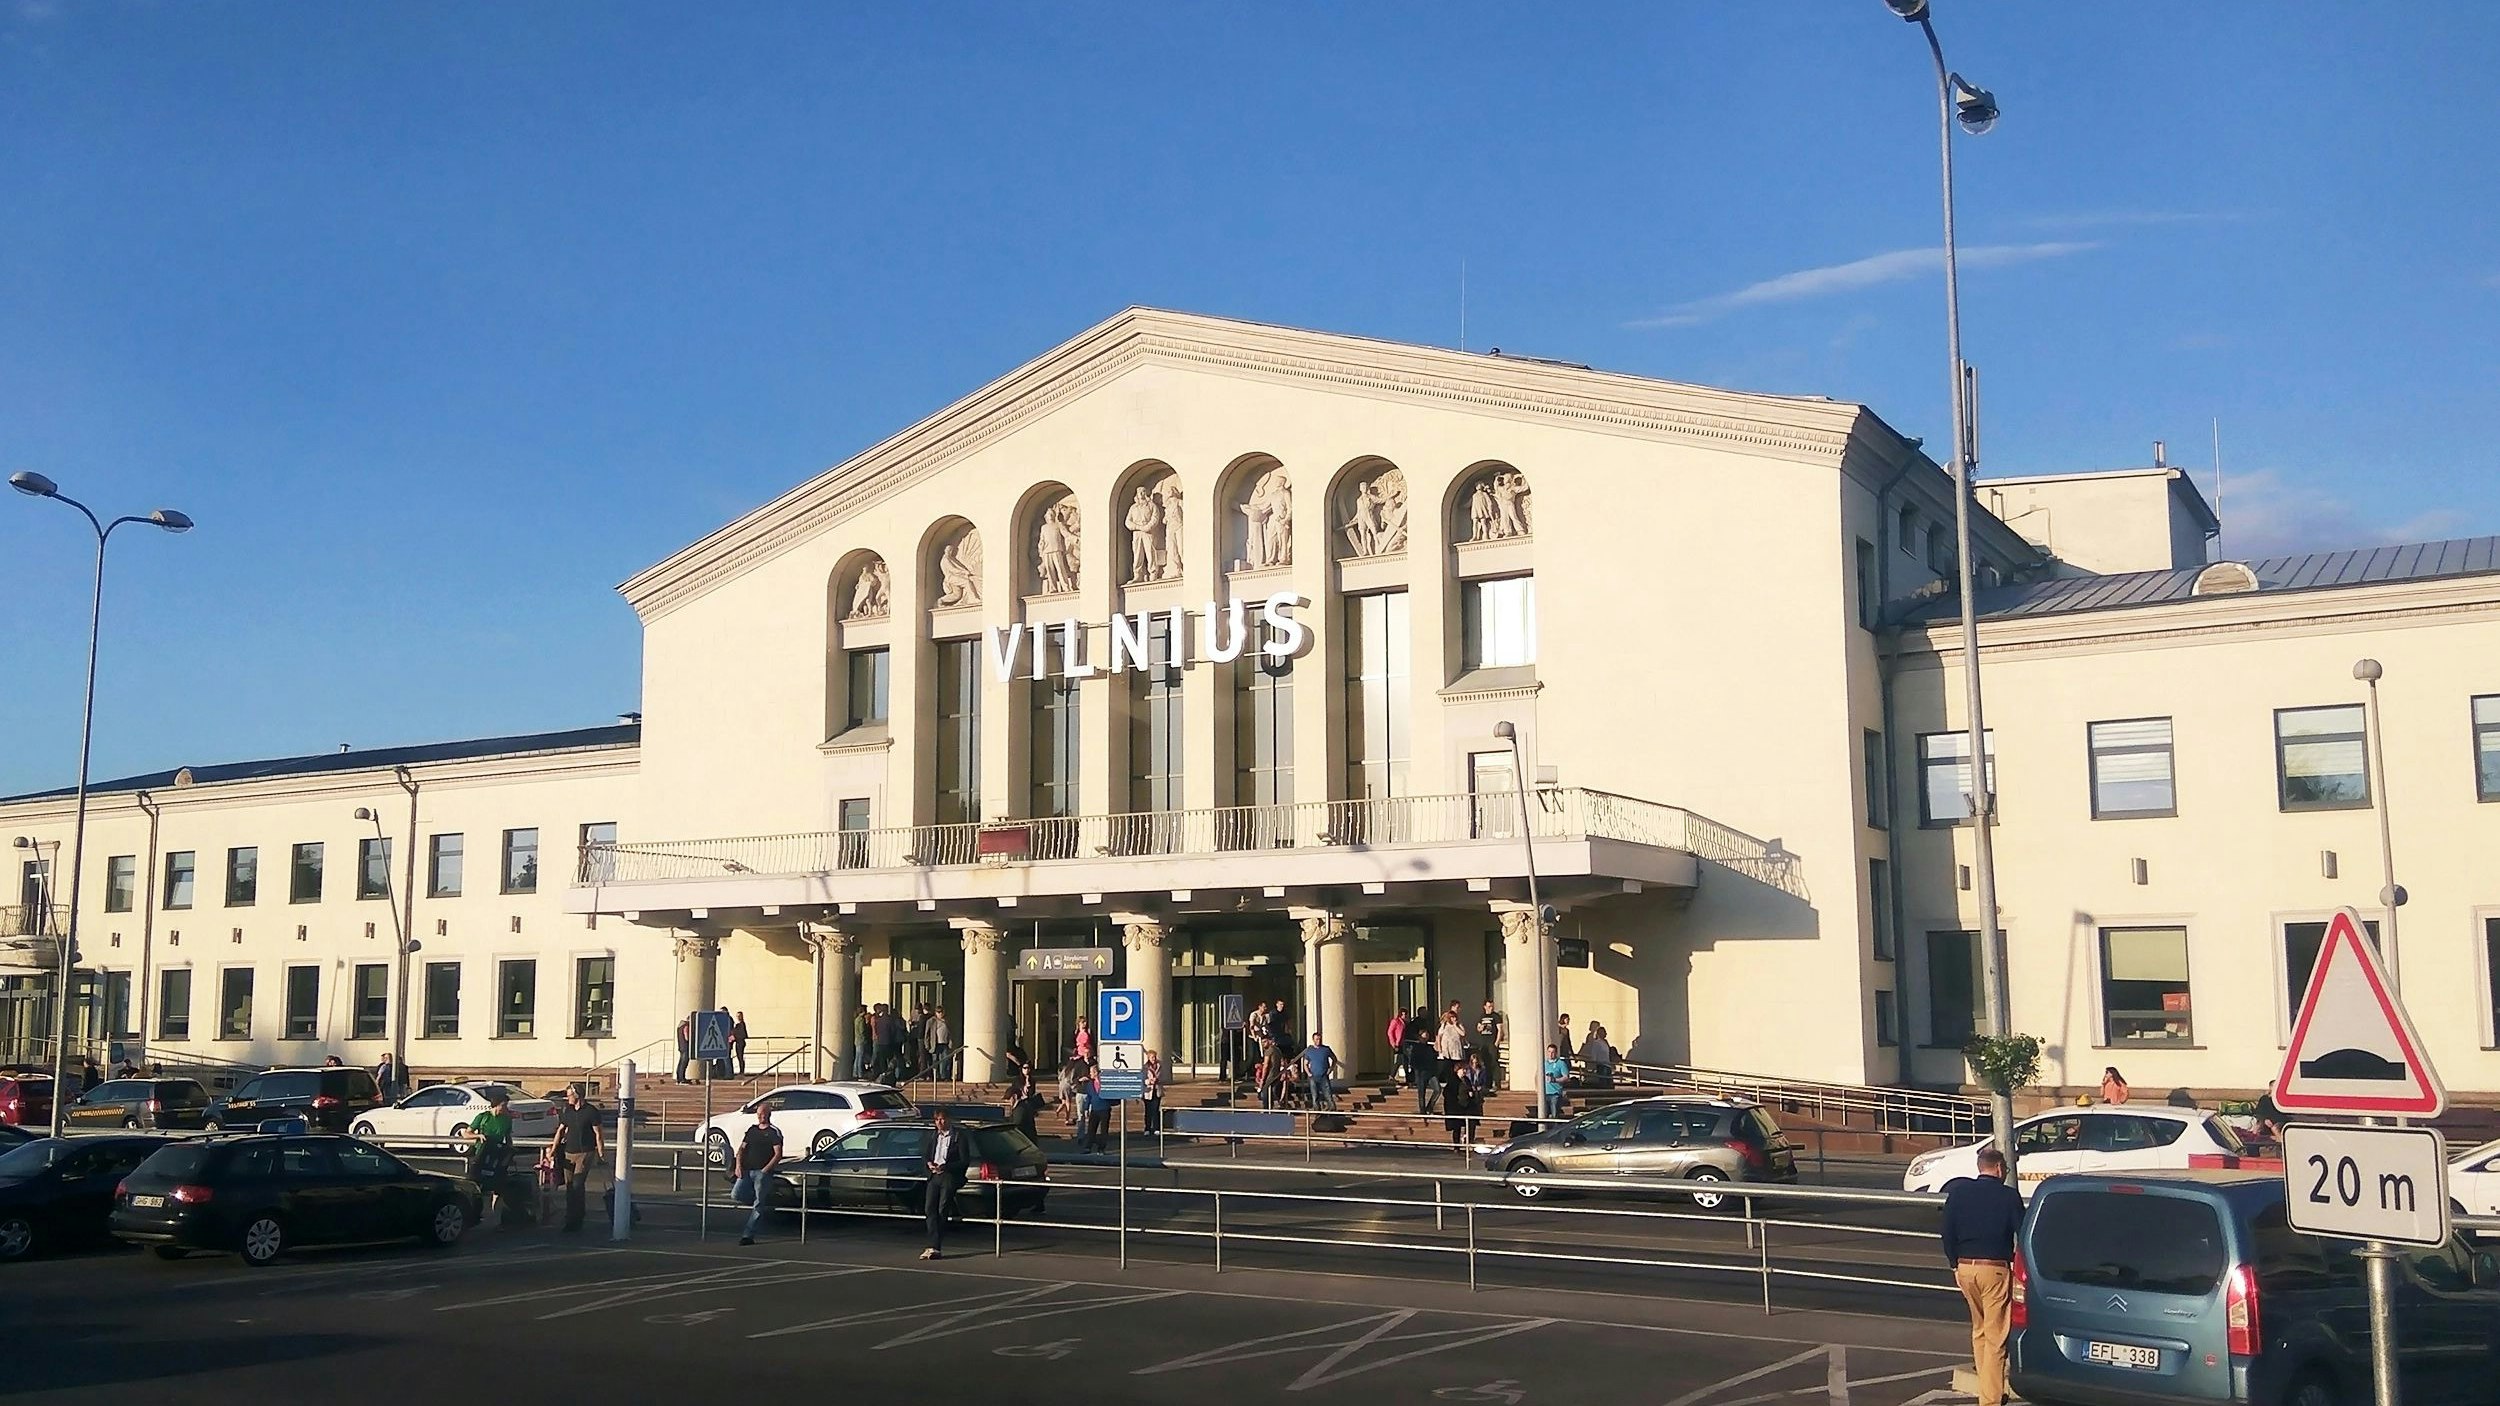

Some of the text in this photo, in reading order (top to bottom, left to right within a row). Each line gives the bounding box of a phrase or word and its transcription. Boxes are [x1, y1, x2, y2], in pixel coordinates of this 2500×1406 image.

[990, 591, 1306, 683] VILNIUS
[1043, 955, 1052, 970] A
[1110, 996, 1133, 1035] P
[2308, 1154, 2415, 1212] 20 m
[2091, 1343, 2120, 1360] EFL
[2129, 1348, 2155, 1365] 338
